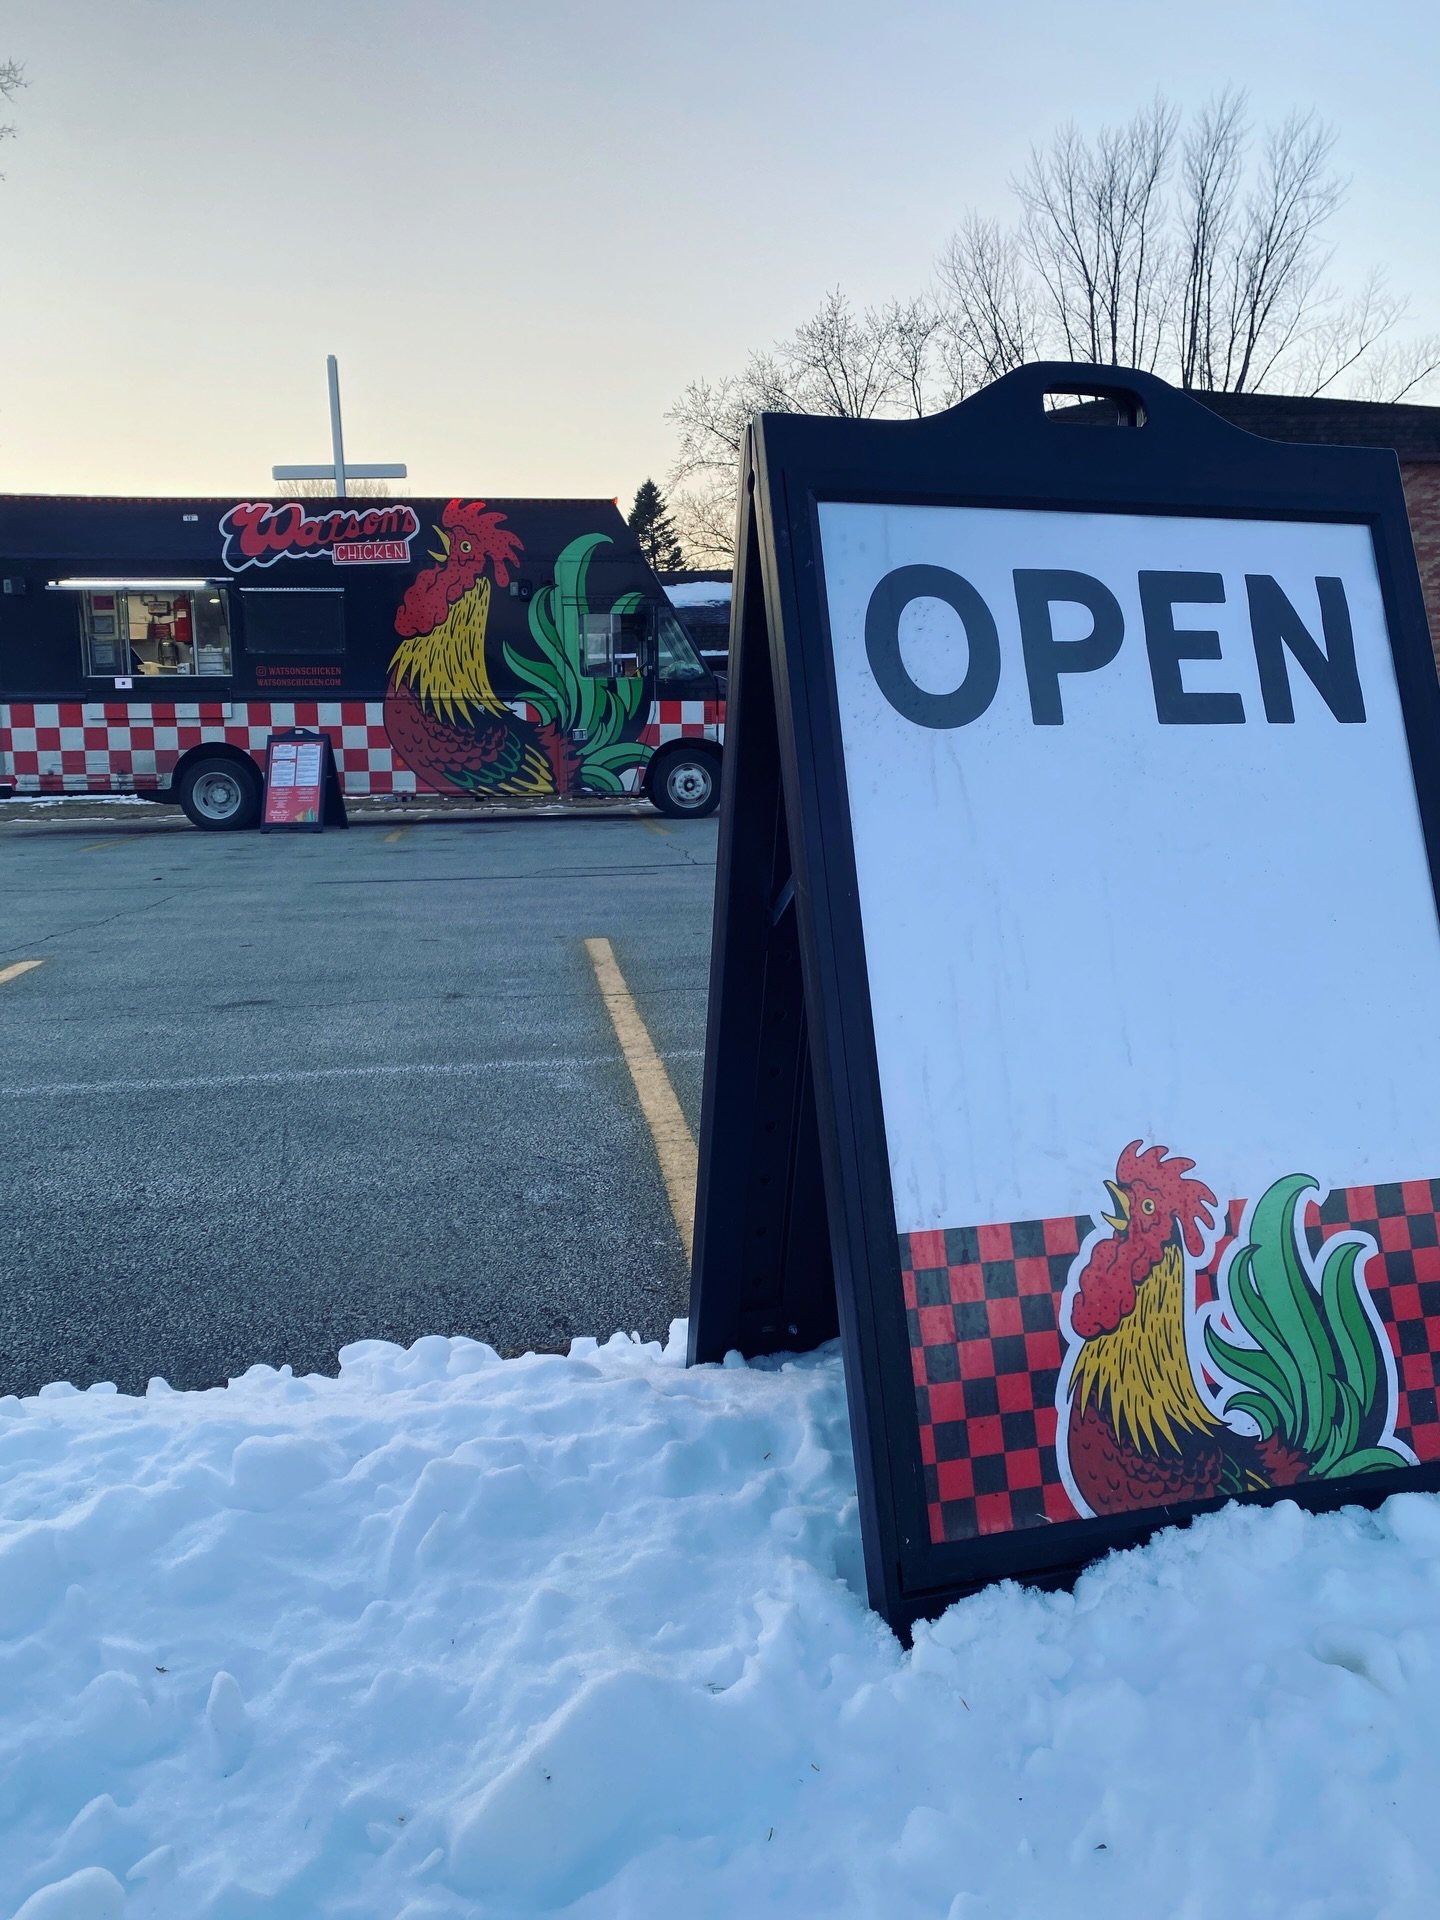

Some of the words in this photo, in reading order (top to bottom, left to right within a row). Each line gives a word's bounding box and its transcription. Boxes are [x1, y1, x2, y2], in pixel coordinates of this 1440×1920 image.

[231, 506, 417, 557] Watson's
[336, 543, 405, 561] CHICKEN
[865, 564, 1367, 729] OPEN
